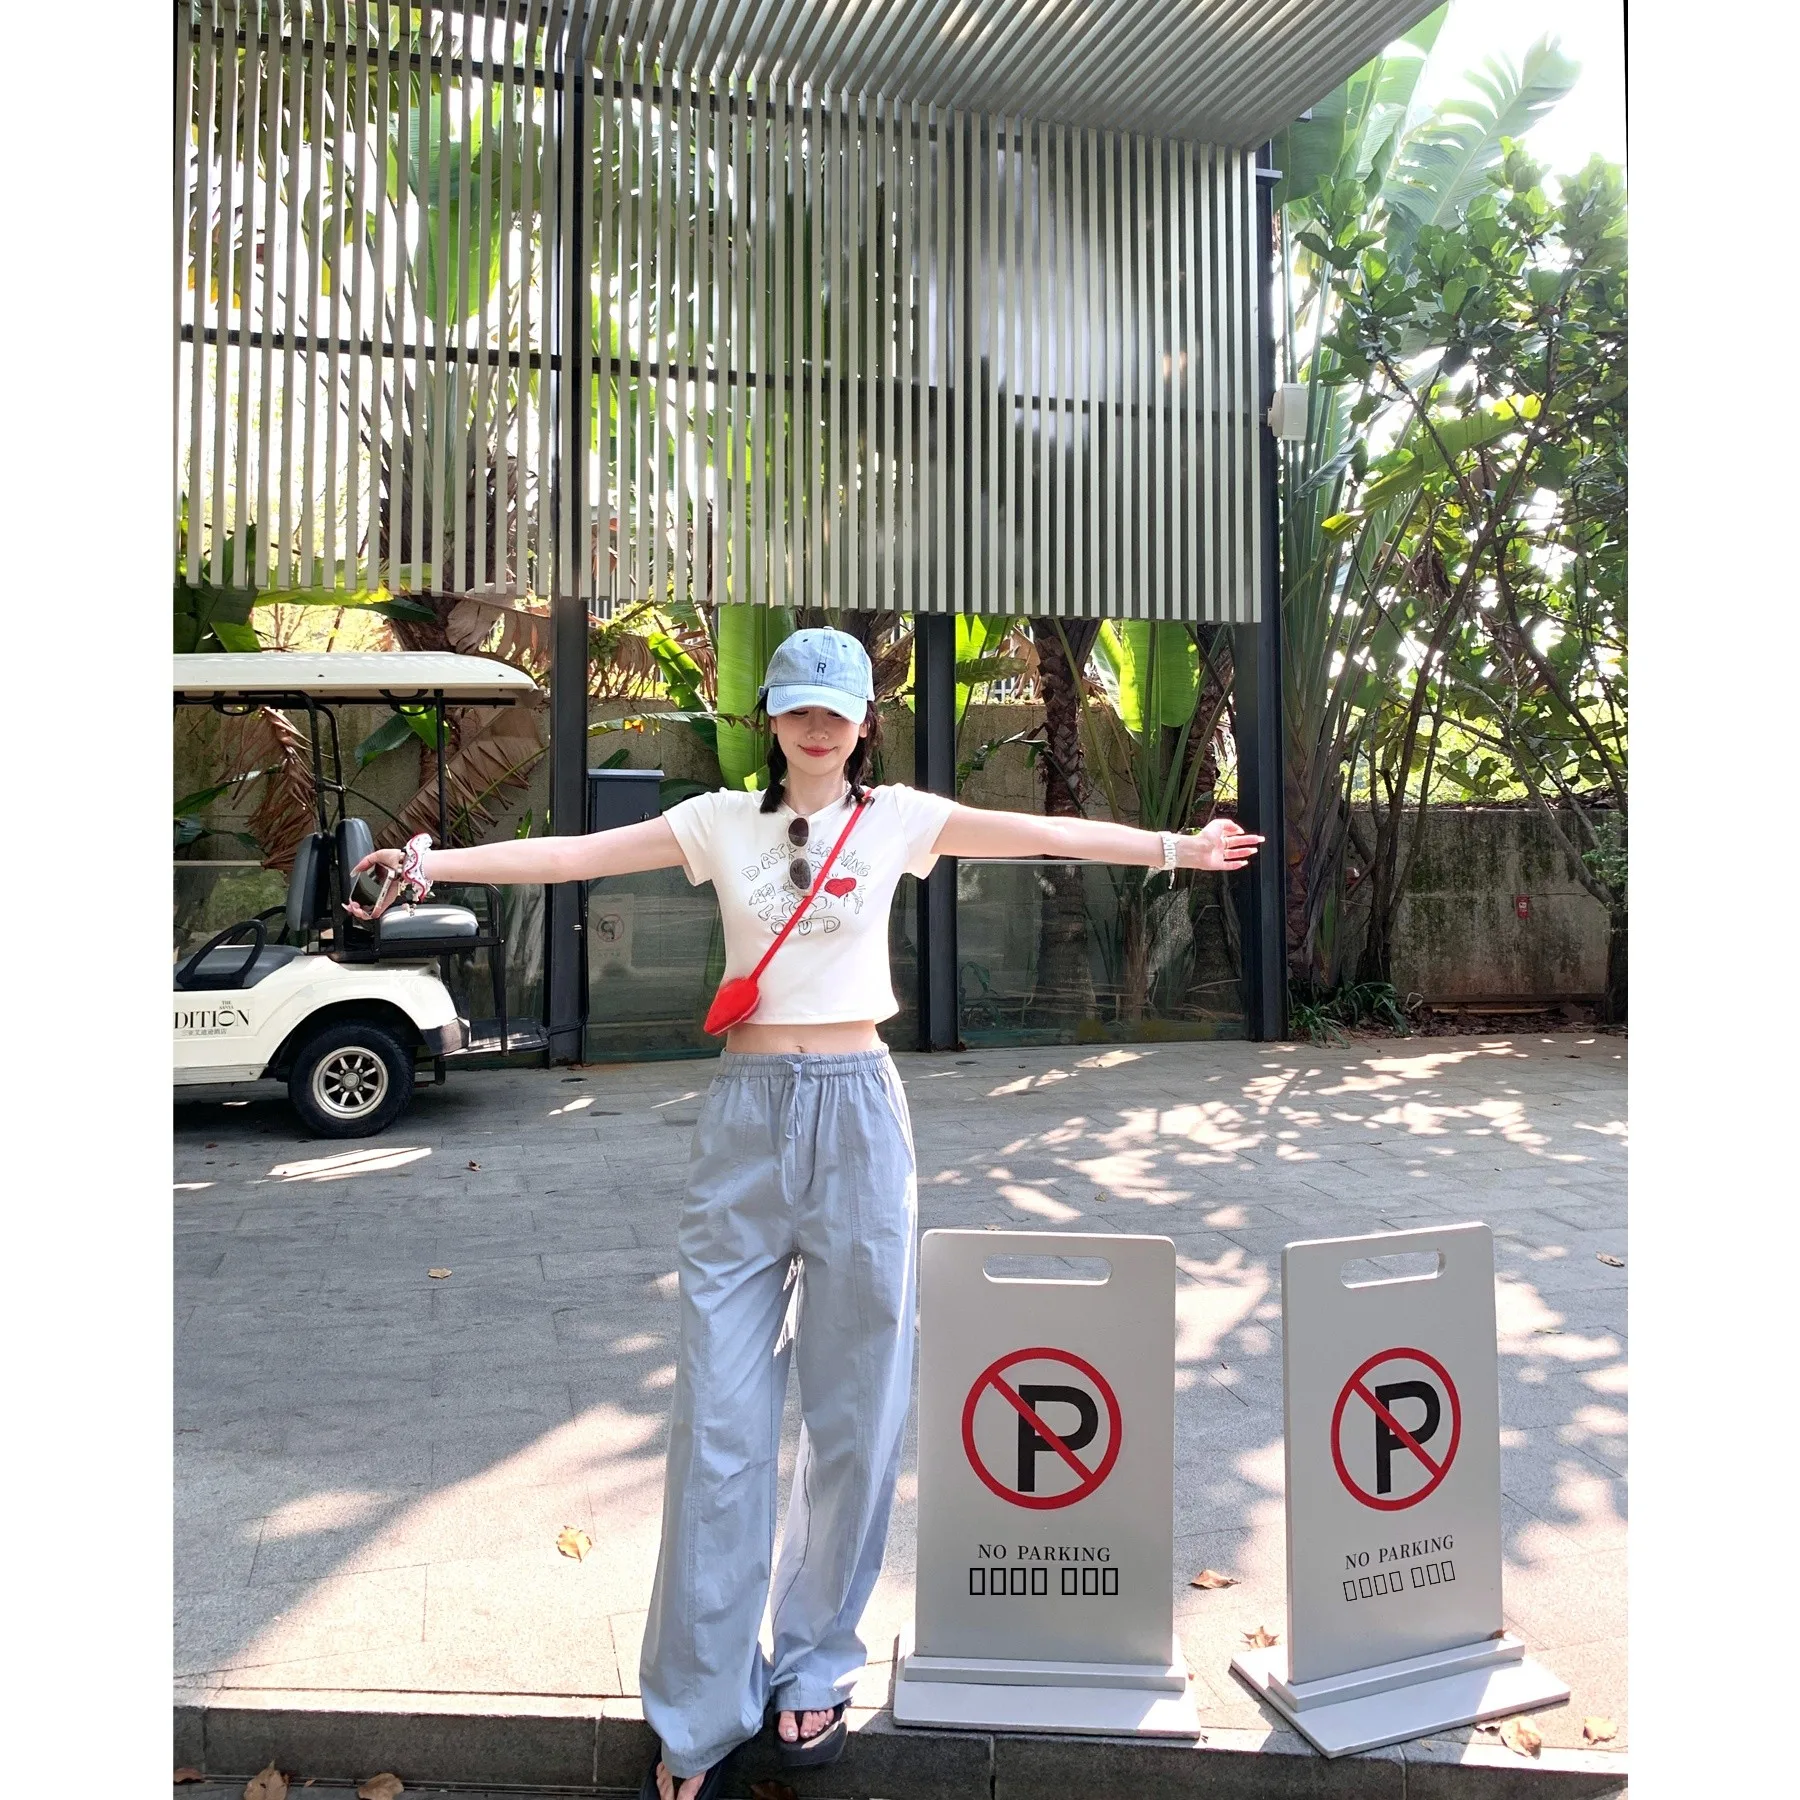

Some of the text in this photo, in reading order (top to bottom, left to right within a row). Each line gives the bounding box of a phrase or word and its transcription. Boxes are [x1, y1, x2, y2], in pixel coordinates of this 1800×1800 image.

[816, 661, 827, 674] R
[1017, 1385, 1098, 1492] P
[1375, 1380, 1441, 1495] P
[977, 1543, 1112, 1563] NO PARKING
[1345, 1534, 1454, 1570] NO PARKING
